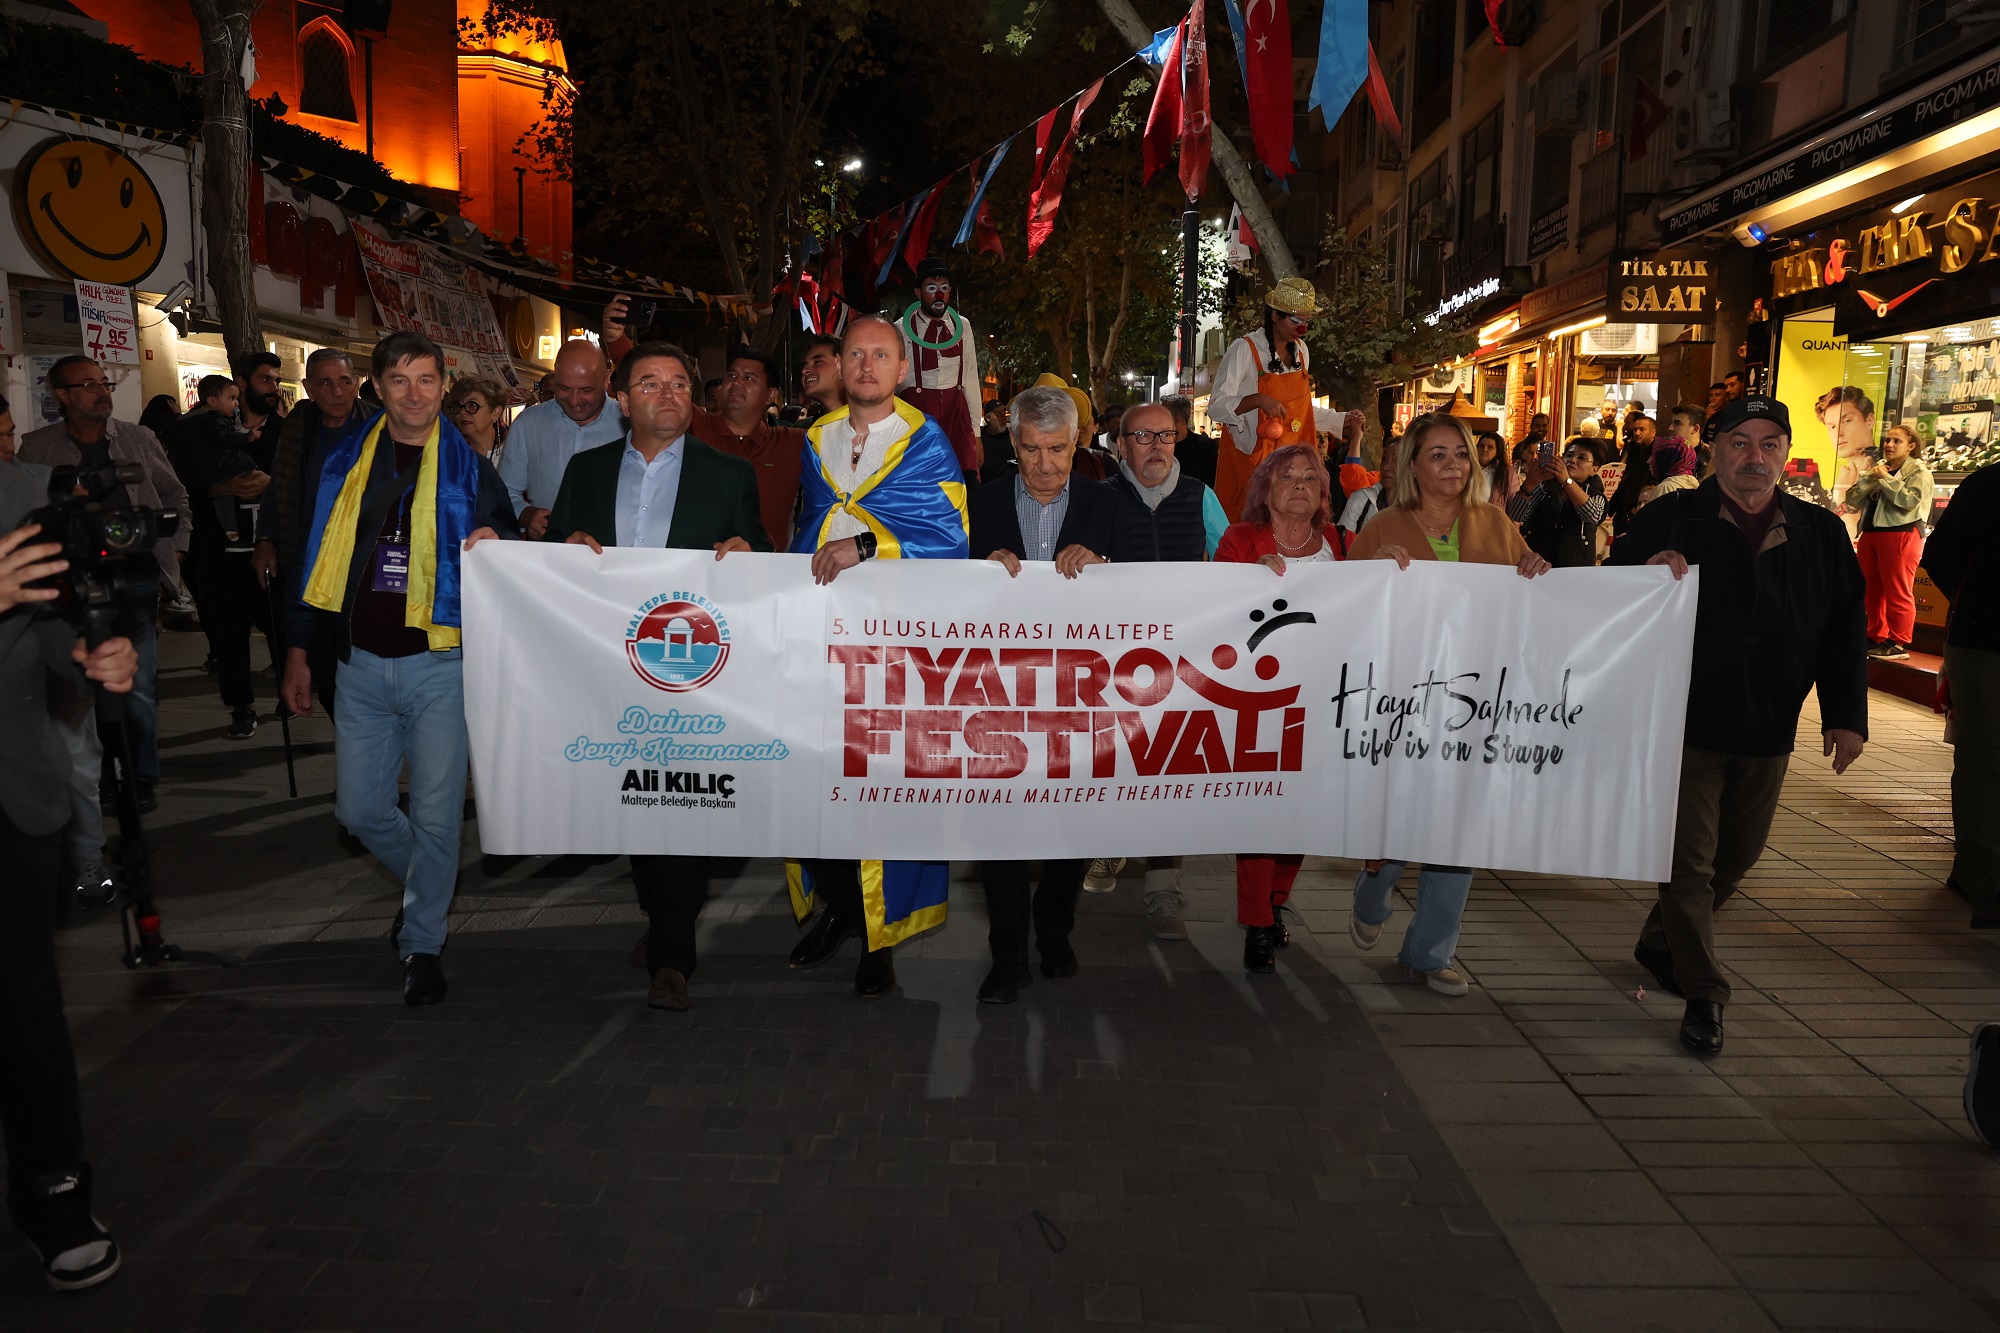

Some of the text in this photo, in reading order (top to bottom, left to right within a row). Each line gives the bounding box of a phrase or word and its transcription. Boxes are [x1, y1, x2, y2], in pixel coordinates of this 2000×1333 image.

[1811, 116, 1893, 170] PACOMARINE
[1733, 162, 1796, 205] PACOMARINE
[1669, 198, 1720, 232] PACOMARINE
[1824, 238, 1850, 286] &
[1858, 210, 1934, 275] TAK
[1620, 256, 1709, 277] TİK & TAK
[79, 283, 103, 301] HALK
[105, 295, 126, 305] ÖZEL
[1620, 284, 1708, 312] SAAT
[81, 305, 108, 324] MISIR
[625, 590, 732, 642] MALTEPE BELEDİYESİ
[832, 619, 1175, 641] 5. ULUSLARARASI MALTEPE
[669, 672, 685, 681] 1992
[1331, 662, 1584, 742] Hayat Sahnede
[616, 705, 727, 735] Daima
[564, 735, 790, 767] Sevgi Kazanacak
[1343, 728, 1564, 775] Life is on Stage
[621, 769, 736, 799] Ali KILIÇ
[830, 780, 1285, 804] 5. INTERNATIONAL MALTEPE THEATRE FESTIVAL
[621, 794, 736, 810] Maltepe Belediye Başkanı
[48, 1181, 75, 1195] PUMA
